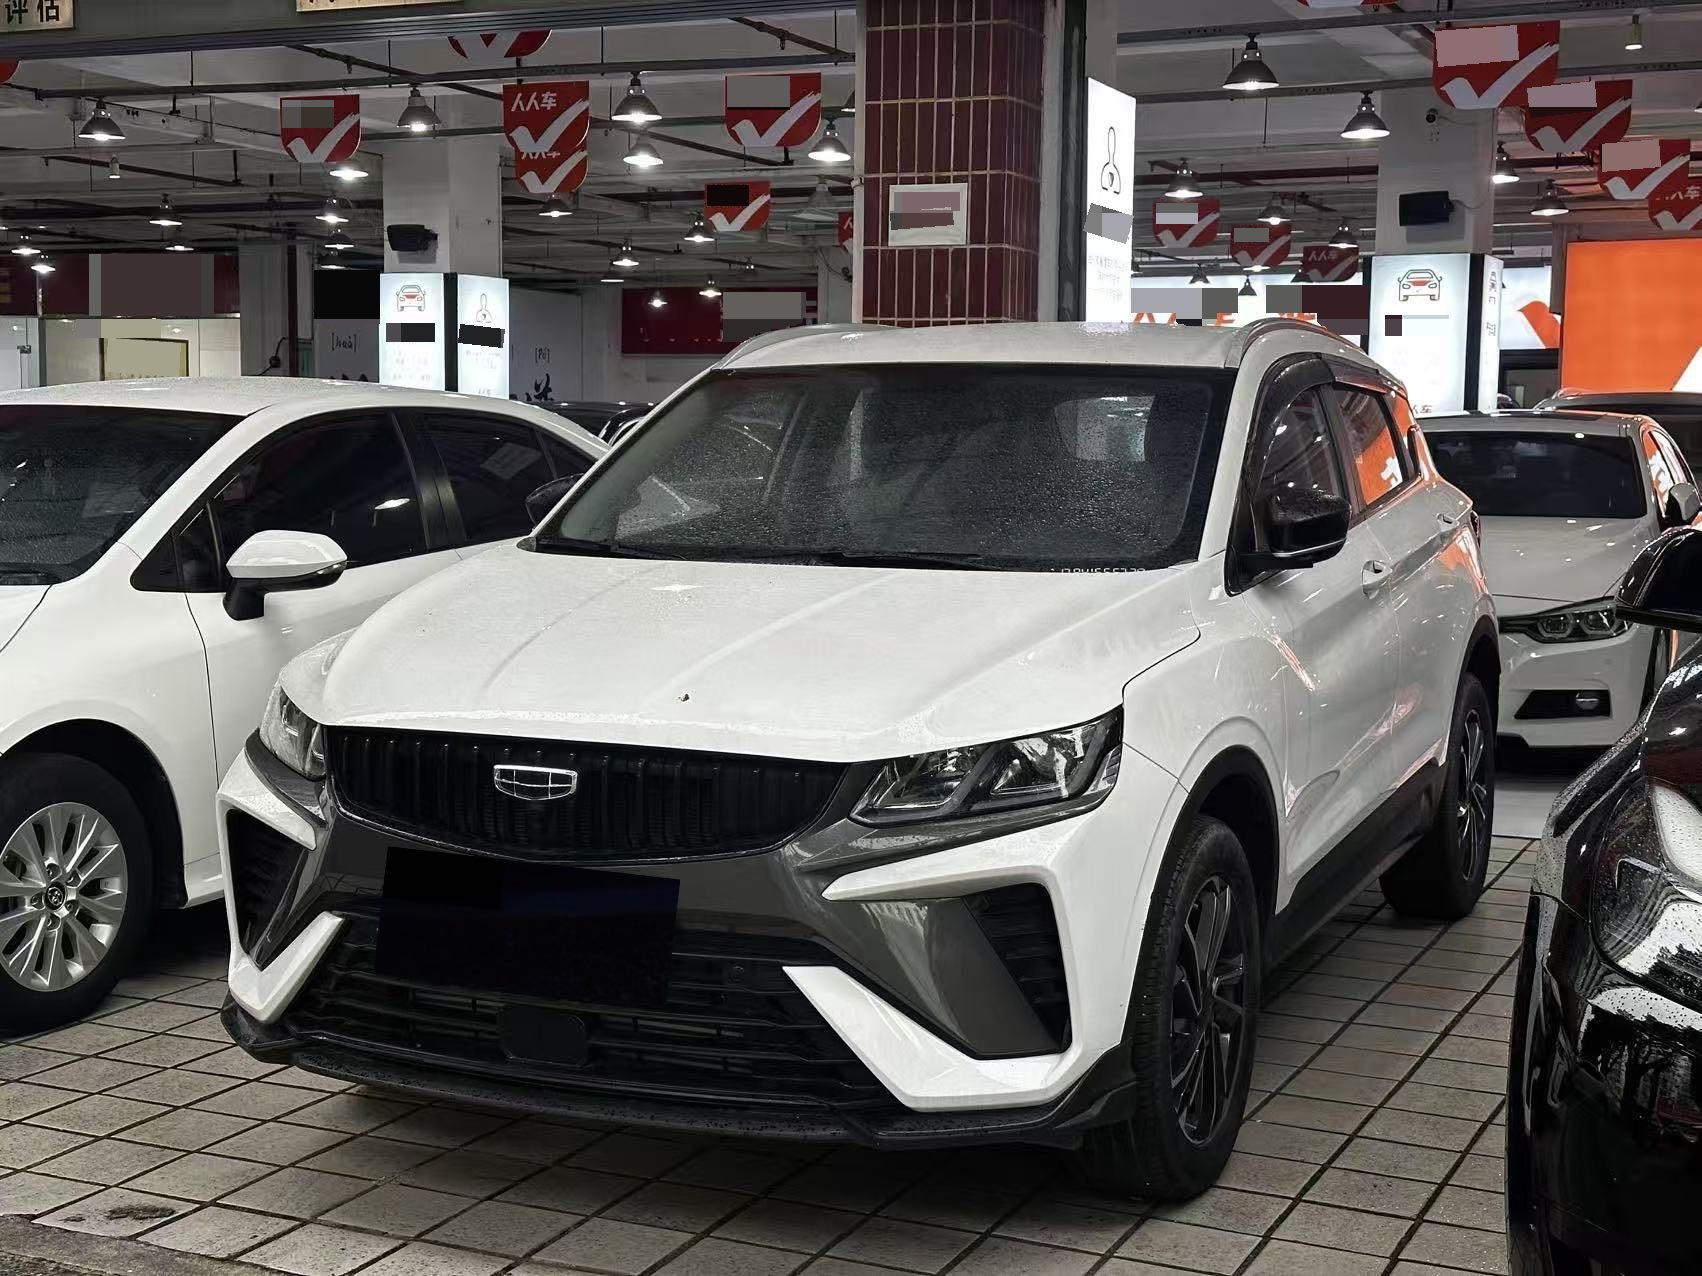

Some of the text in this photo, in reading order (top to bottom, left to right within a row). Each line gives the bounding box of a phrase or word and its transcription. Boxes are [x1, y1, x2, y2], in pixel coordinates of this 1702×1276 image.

[511, 92, 557, 112] 人人车
[1308, 250, 1337, 261] 人人车
